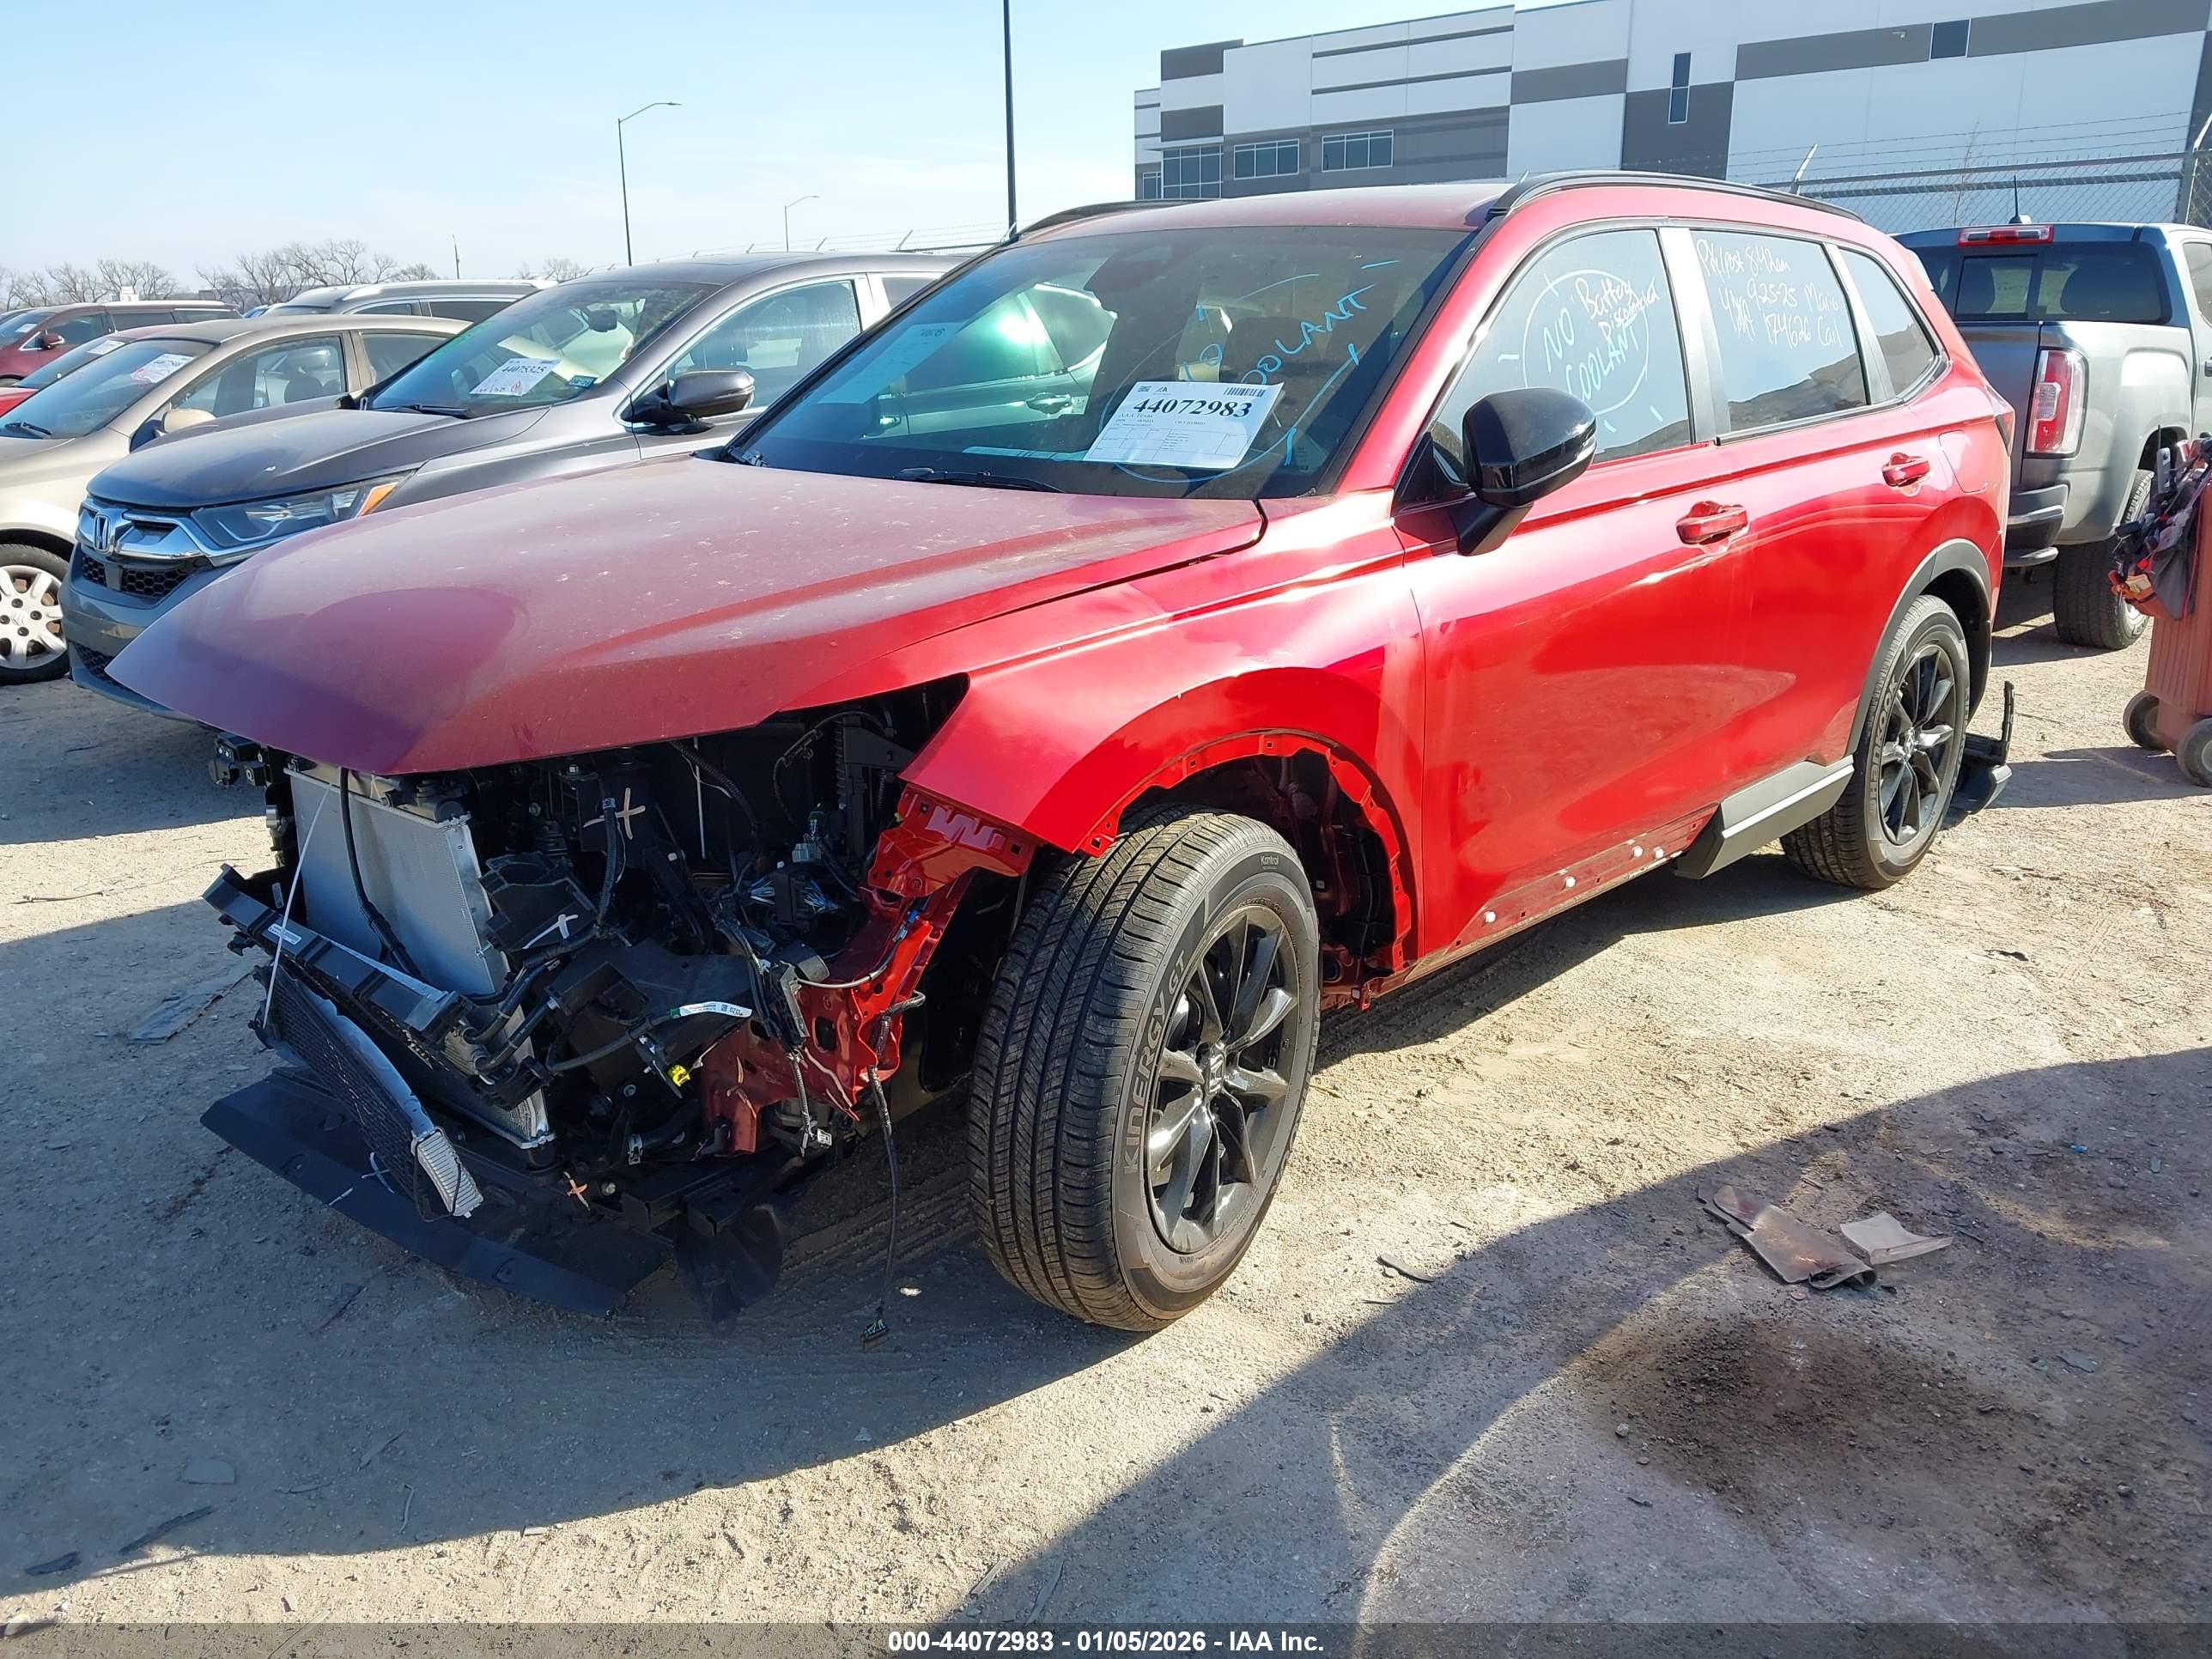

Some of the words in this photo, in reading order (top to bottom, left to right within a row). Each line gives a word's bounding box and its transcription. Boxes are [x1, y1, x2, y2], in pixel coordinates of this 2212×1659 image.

[1543, 307, 1575, 373] NO
[1133, 398, 1252, 417] 44072983
[1168, 949, 1186, 995] GT
